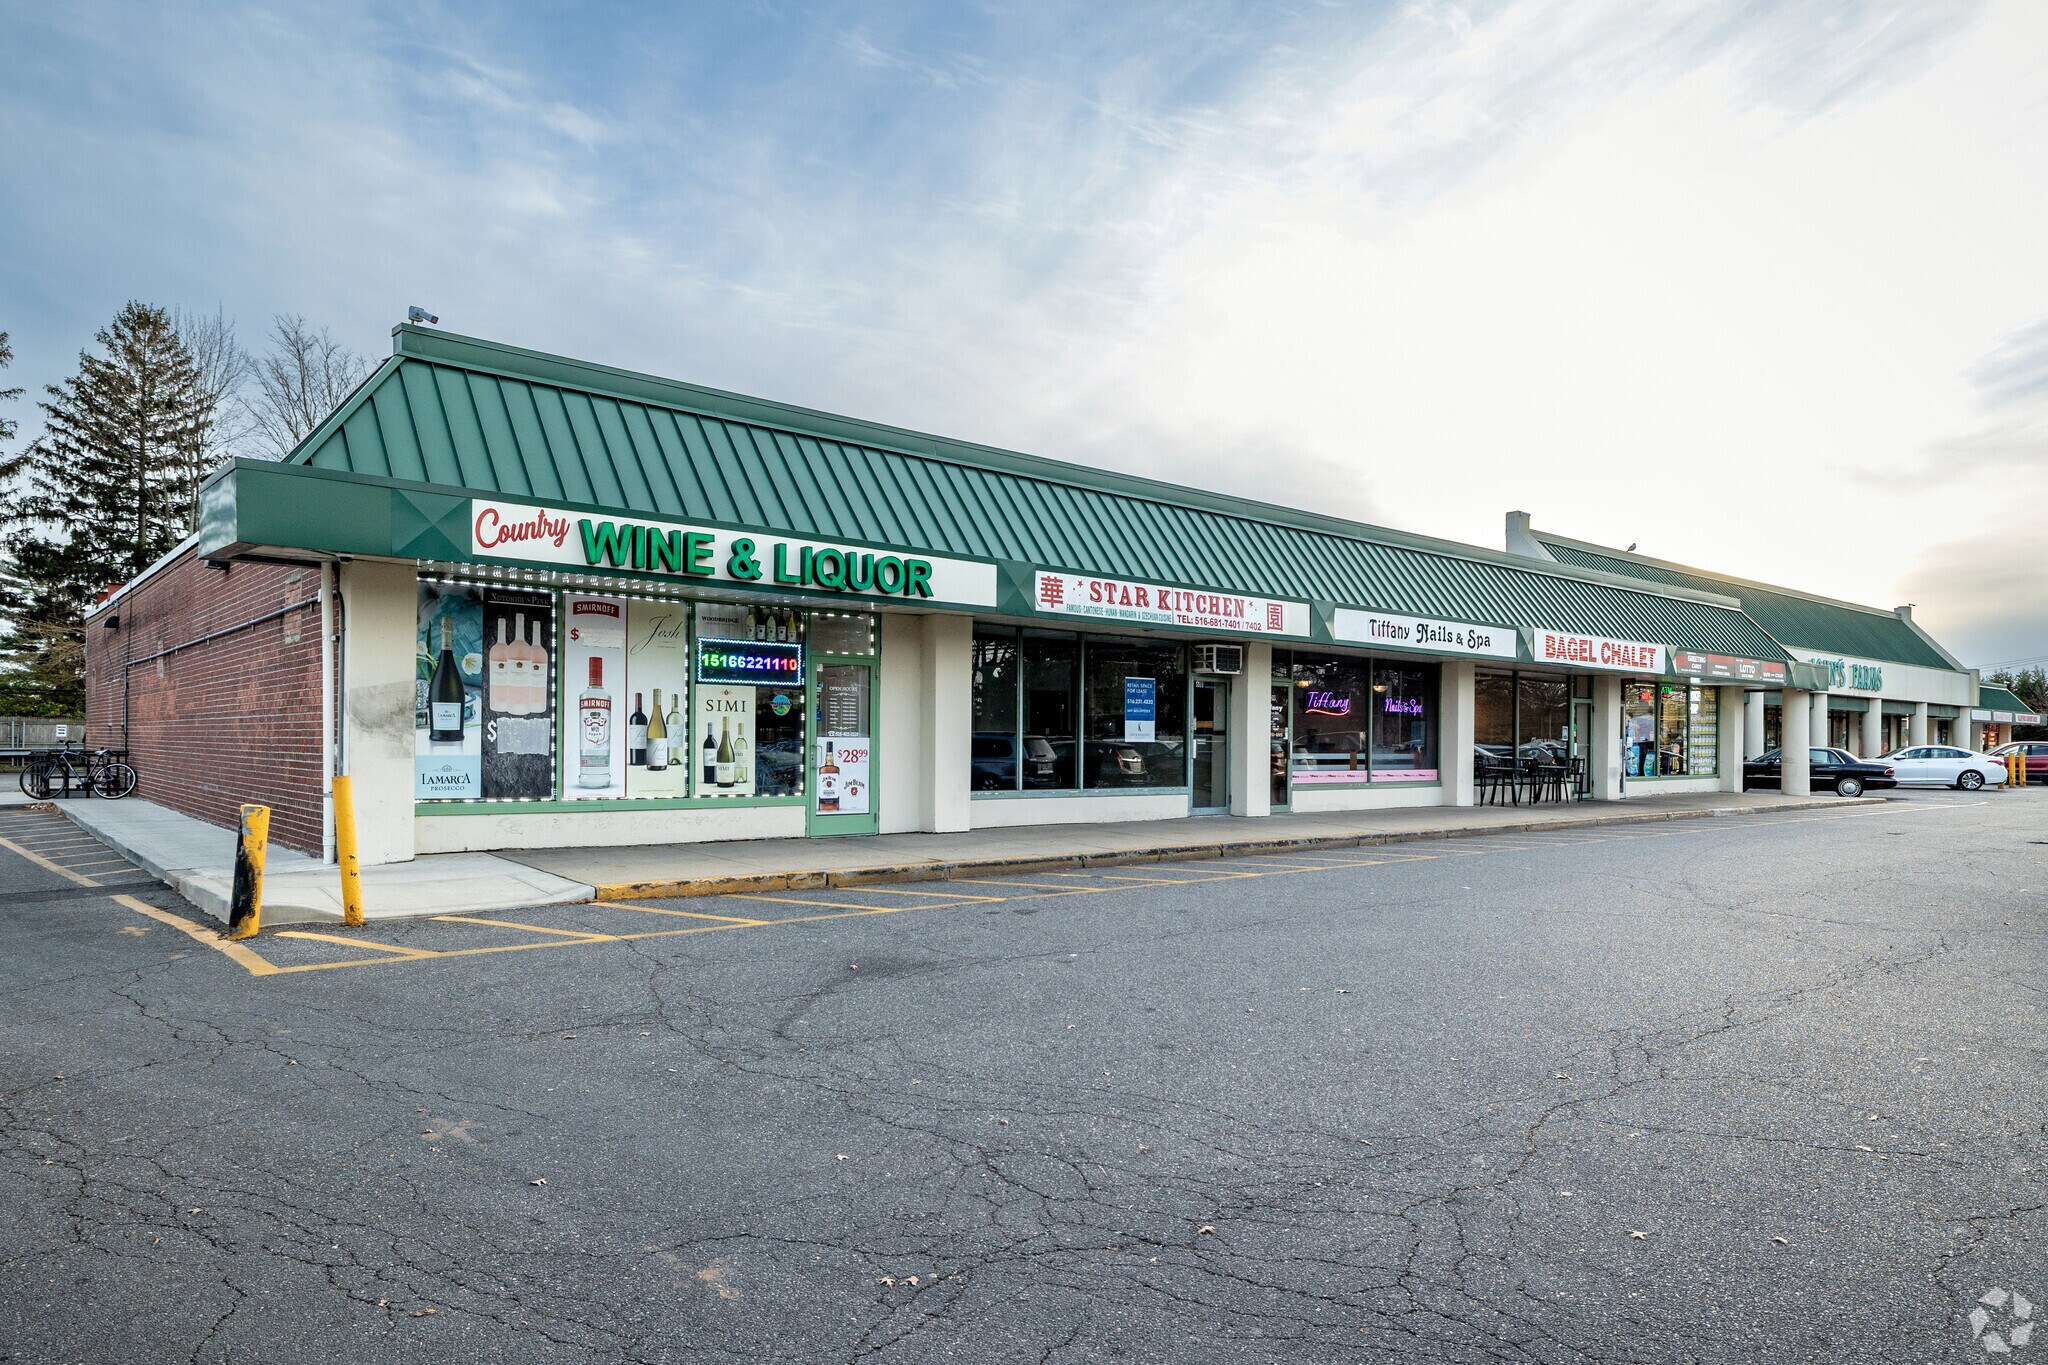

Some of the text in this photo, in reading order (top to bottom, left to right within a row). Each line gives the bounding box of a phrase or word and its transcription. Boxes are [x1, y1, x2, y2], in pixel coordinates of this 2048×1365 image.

[475, 507, 571, 549] Country
[577, 518, 935, 598] WINE & LIQUOR
[1040, 576, 1064, 608] 華
[1089, 580, 1246, 619] STAR KITCHEN
[576, 604, 616, 614] SMIRNOFF
[701, 615, 740, 624] WOODBRIDGE
[1266, 602, 1284, 632] 園
[629, 613, 684, 656] Josh
[1177, 614, 1194, 625] TEL:
[1194, 616, 1241, 630] 516-681-7401
[1245, 621, 1262, 632] 7402
[1369, 618, 1491, 650] Tiffany Nails & Spa
[701, 653, 798, 671] 15166221110
[1545, 634, 1657, 669] BAGEL CHALET
[580, 699, 611, 709] SMIRNOFF
[705, 699, 747, 713] SIMI
[1307, 691, 1350, 712] Tiffany
[487, 720, 497, 743] $
